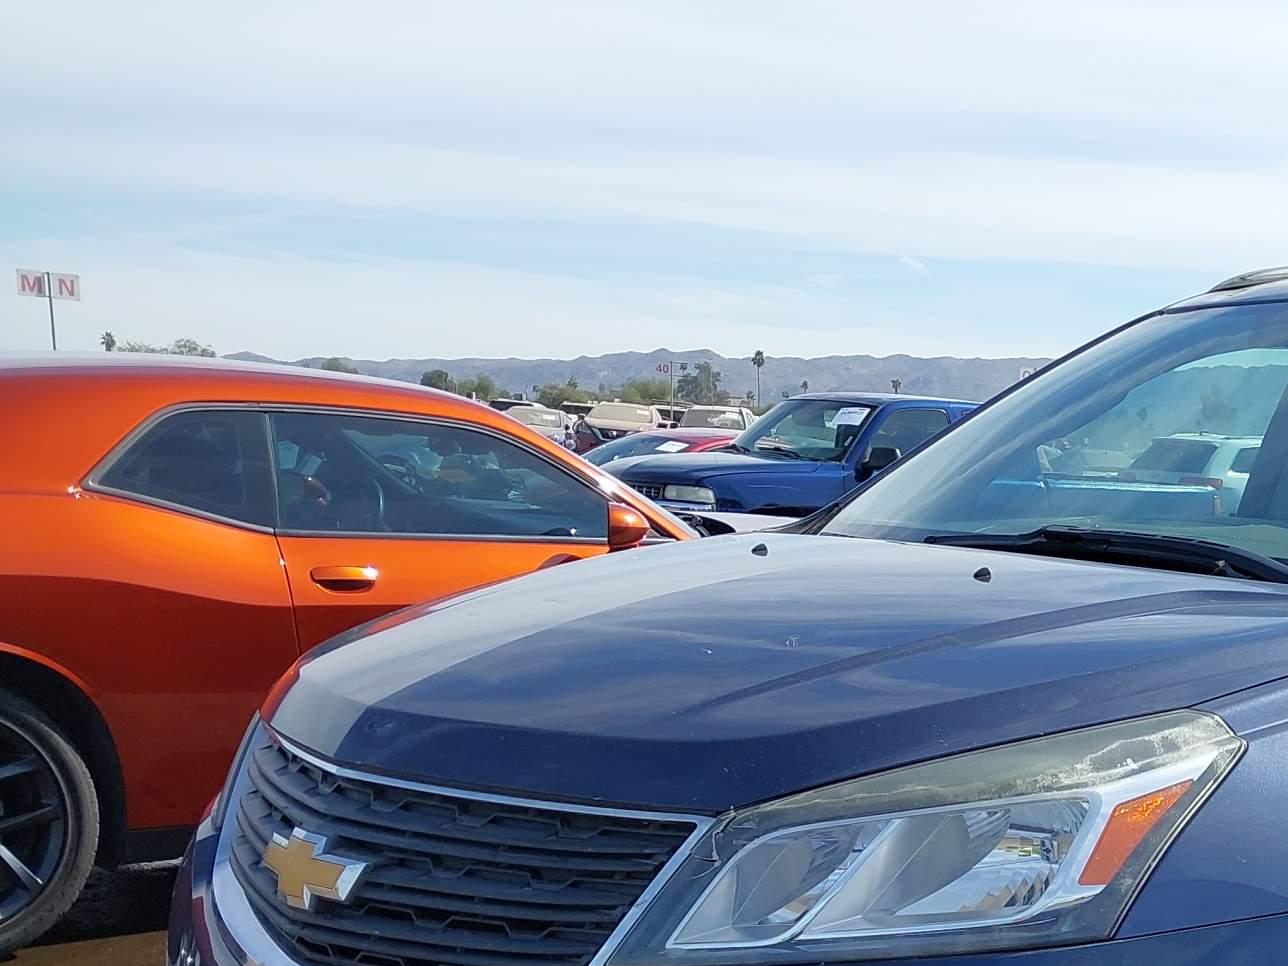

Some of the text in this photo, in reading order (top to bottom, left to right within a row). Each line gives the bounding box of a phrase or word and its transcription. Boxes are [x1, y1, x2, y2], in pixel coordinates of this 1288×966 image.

[20, 274, 43, 294] M
[57, 278, 75, 297] N
[655, 363, 669, 374] 40
